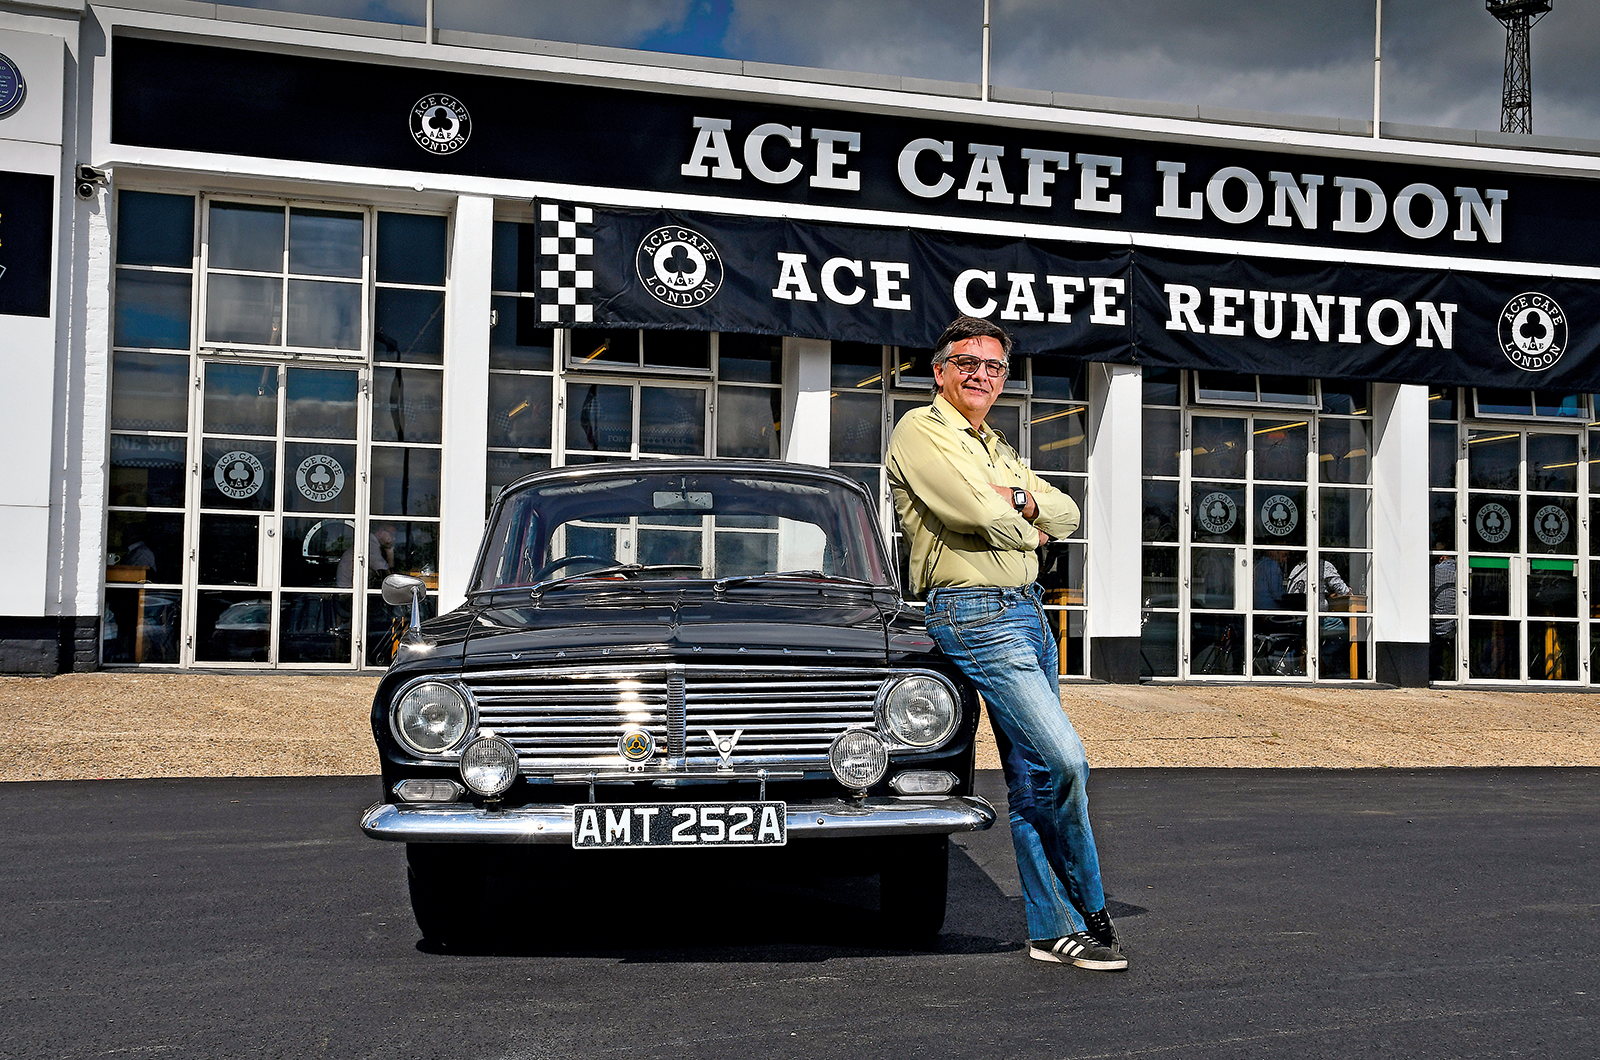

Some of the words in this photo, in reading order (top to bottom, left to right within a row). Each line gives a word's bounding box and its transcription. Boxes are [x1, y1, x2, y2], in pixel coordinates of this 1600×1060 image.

[415, 97, 437, 118] ACE
[440, 97, 467, 121] CAFE
[414, 129, 465, 152] LONDON
[681, 116, 861, 191] ACE
[898, 138, 1123, 214] CAFE
[1155, 160, 1509, 243] LONDON
[643, 230, 672, 256] ACE
[677, 230, 716, 261] CAFE
[645, 275, 716, 304] LONDON
[667, 277, 694, 285] ACE
[771, 251, 912, 311] ACE
[952, 268, 1126, 326] CAFE
[1163, 283, 1458, 350] REUNION
[1504, 296, 1529, 323] ACE
[1532, 296, 1563, 326] CAFE
[1504, 341, 1561, 368] LONDON
[1521, 342, 1546, 350] ACE
[218, 453, 236, 471] ACE
[239, 453, 261, 472] CAFE
[300, 457, 318, 474] ACE
[320, 456, 342, 475] CAFE
[218, 480, 259, 497] LONDON
[300, 484, 340, 500] LONDON
[1202, 494, 1215, 510] ACE
[1264, 496, 1277, 511] ACE
[1202, 518, 1234, 532] LONDON
[1264, 520, 1295, 534] LONDON
[577, 809, 659, 844] AMT
[671, 806, 780, 842] 252A
